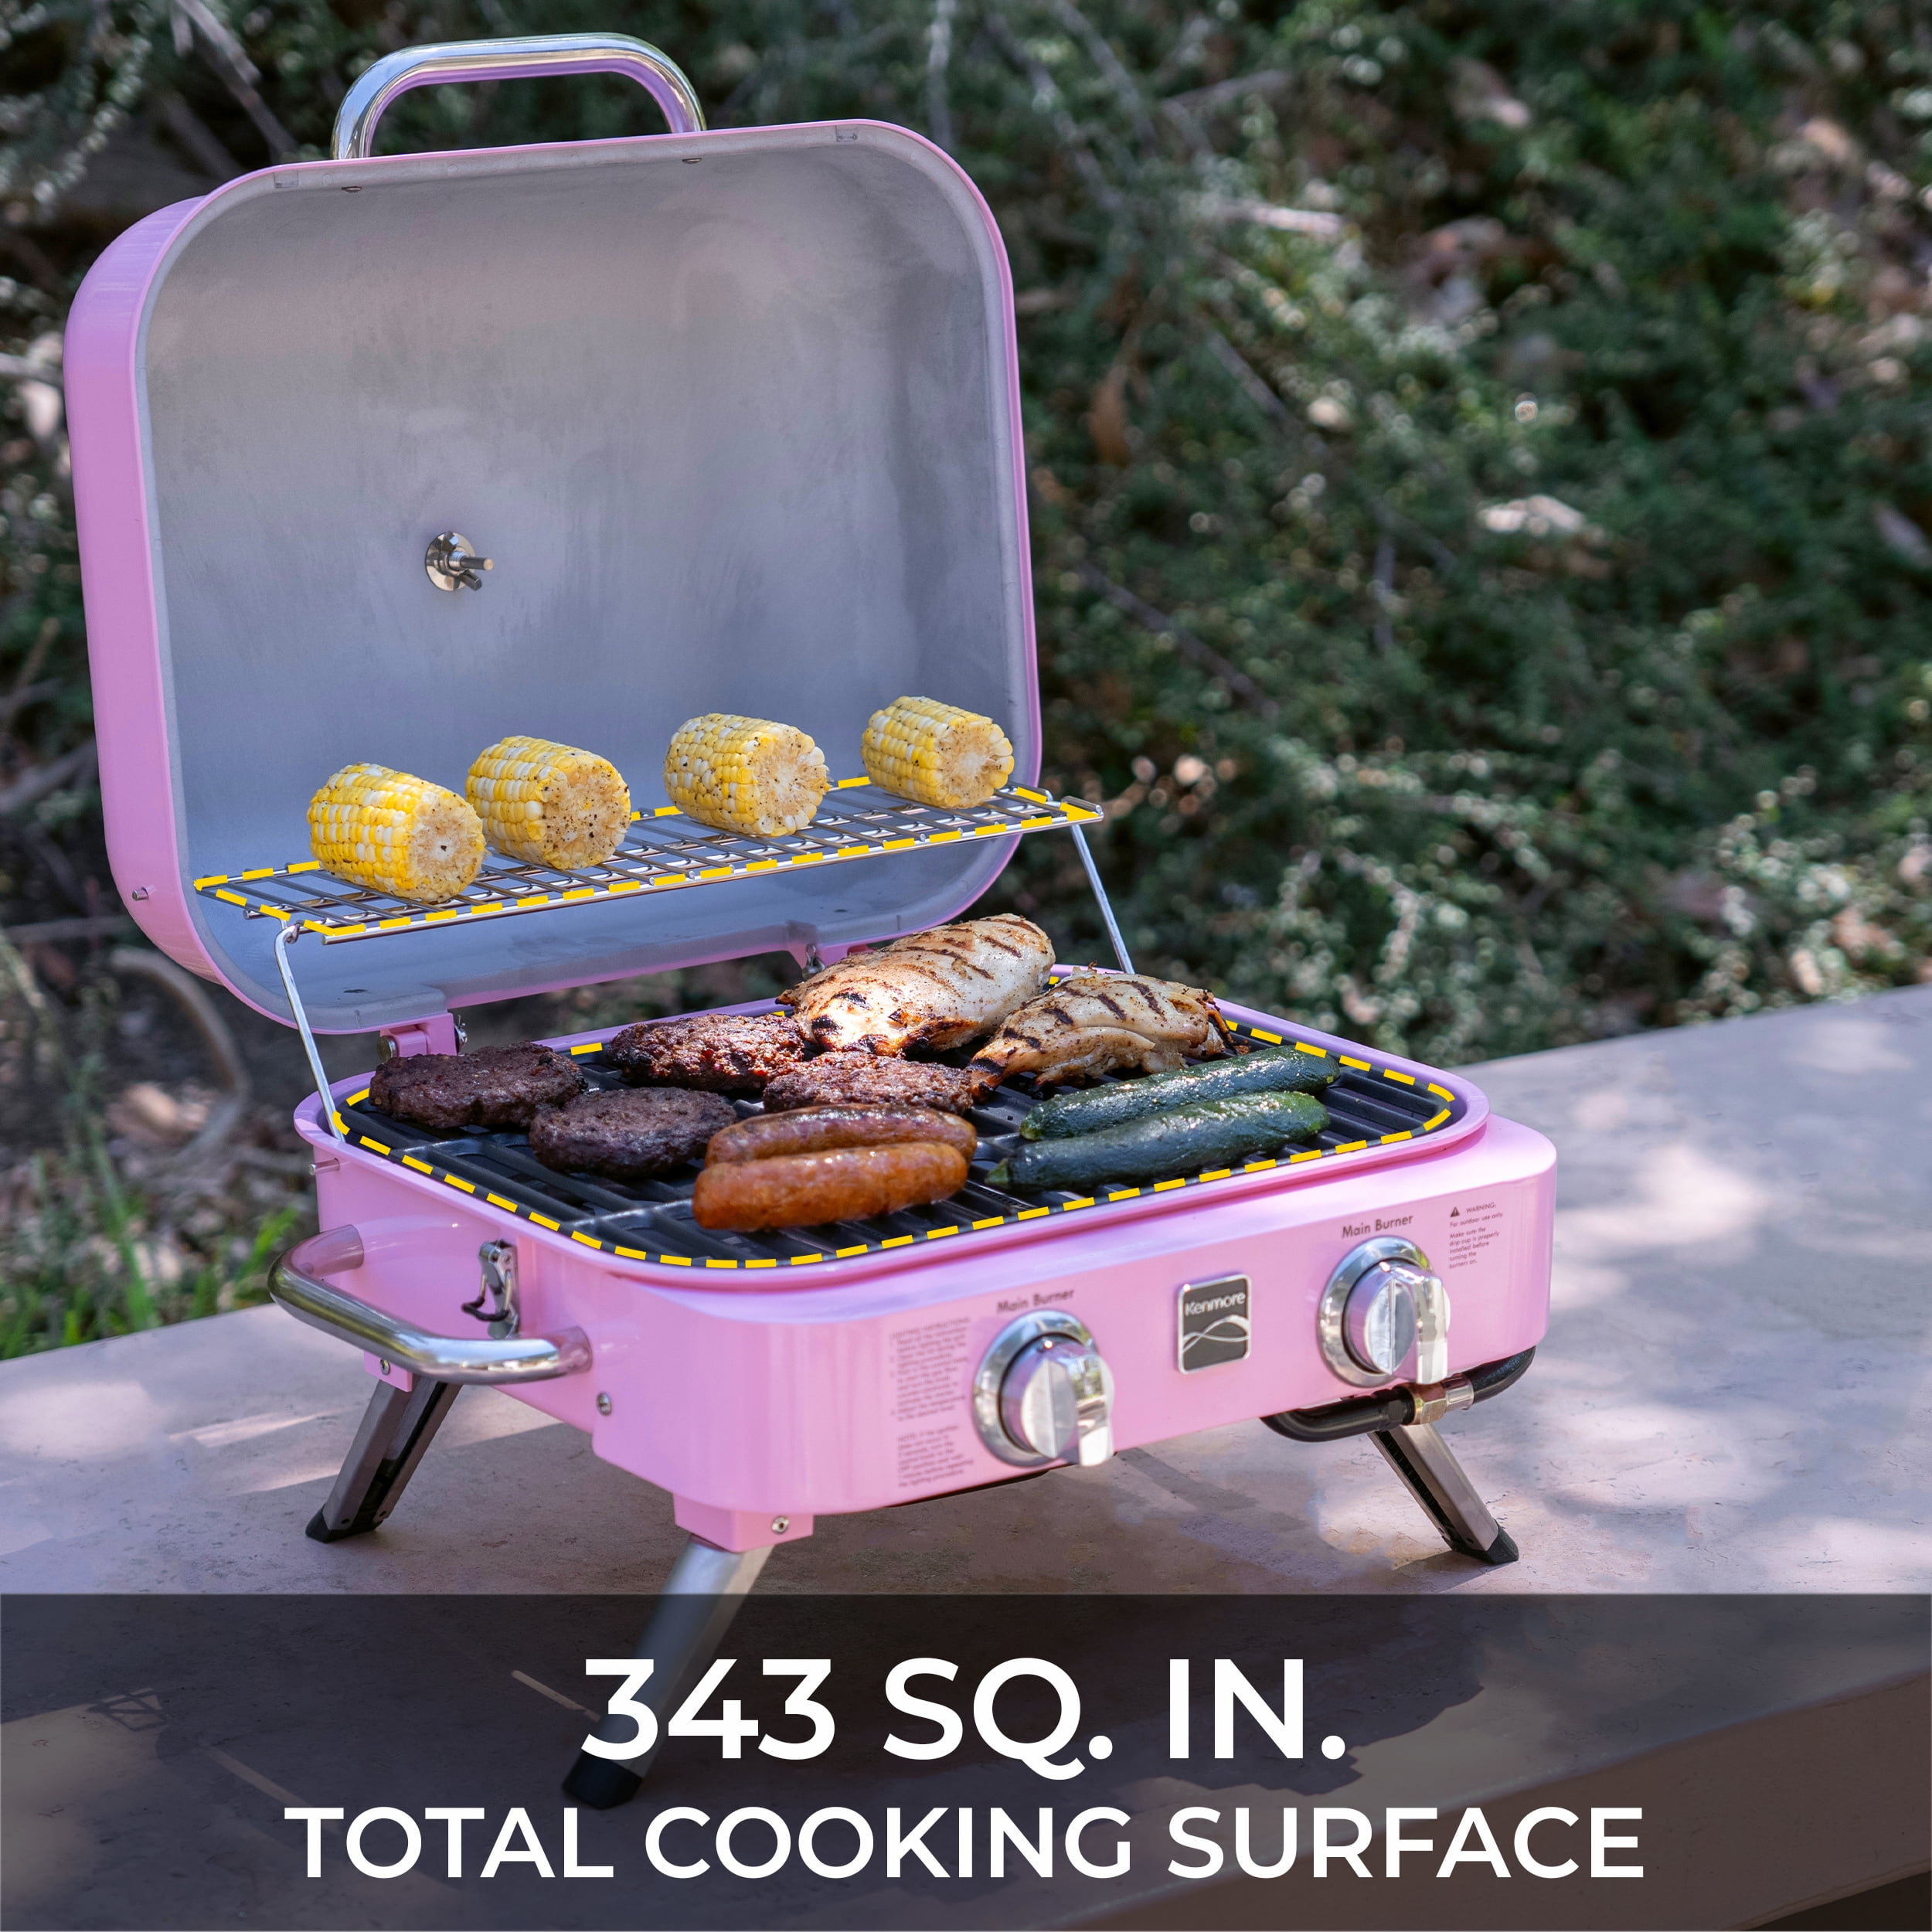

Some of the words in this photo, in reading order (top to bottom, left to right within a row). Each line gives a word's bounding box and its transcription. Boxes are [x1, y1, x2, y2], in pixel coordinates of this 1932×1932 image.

[1342, 1222, 1371, 1238] Main
[1376, 1216, 1413, 1232] Burner
[1478, 1230, 1500, 1241] properly
[1449, 1245, 1471, 1253] installed
[996, 1298, 1029, 1314] Main
[1032, 1289, 1074, 1307] Burner
[1185, 1291, 1246, 1316] Kenmore
